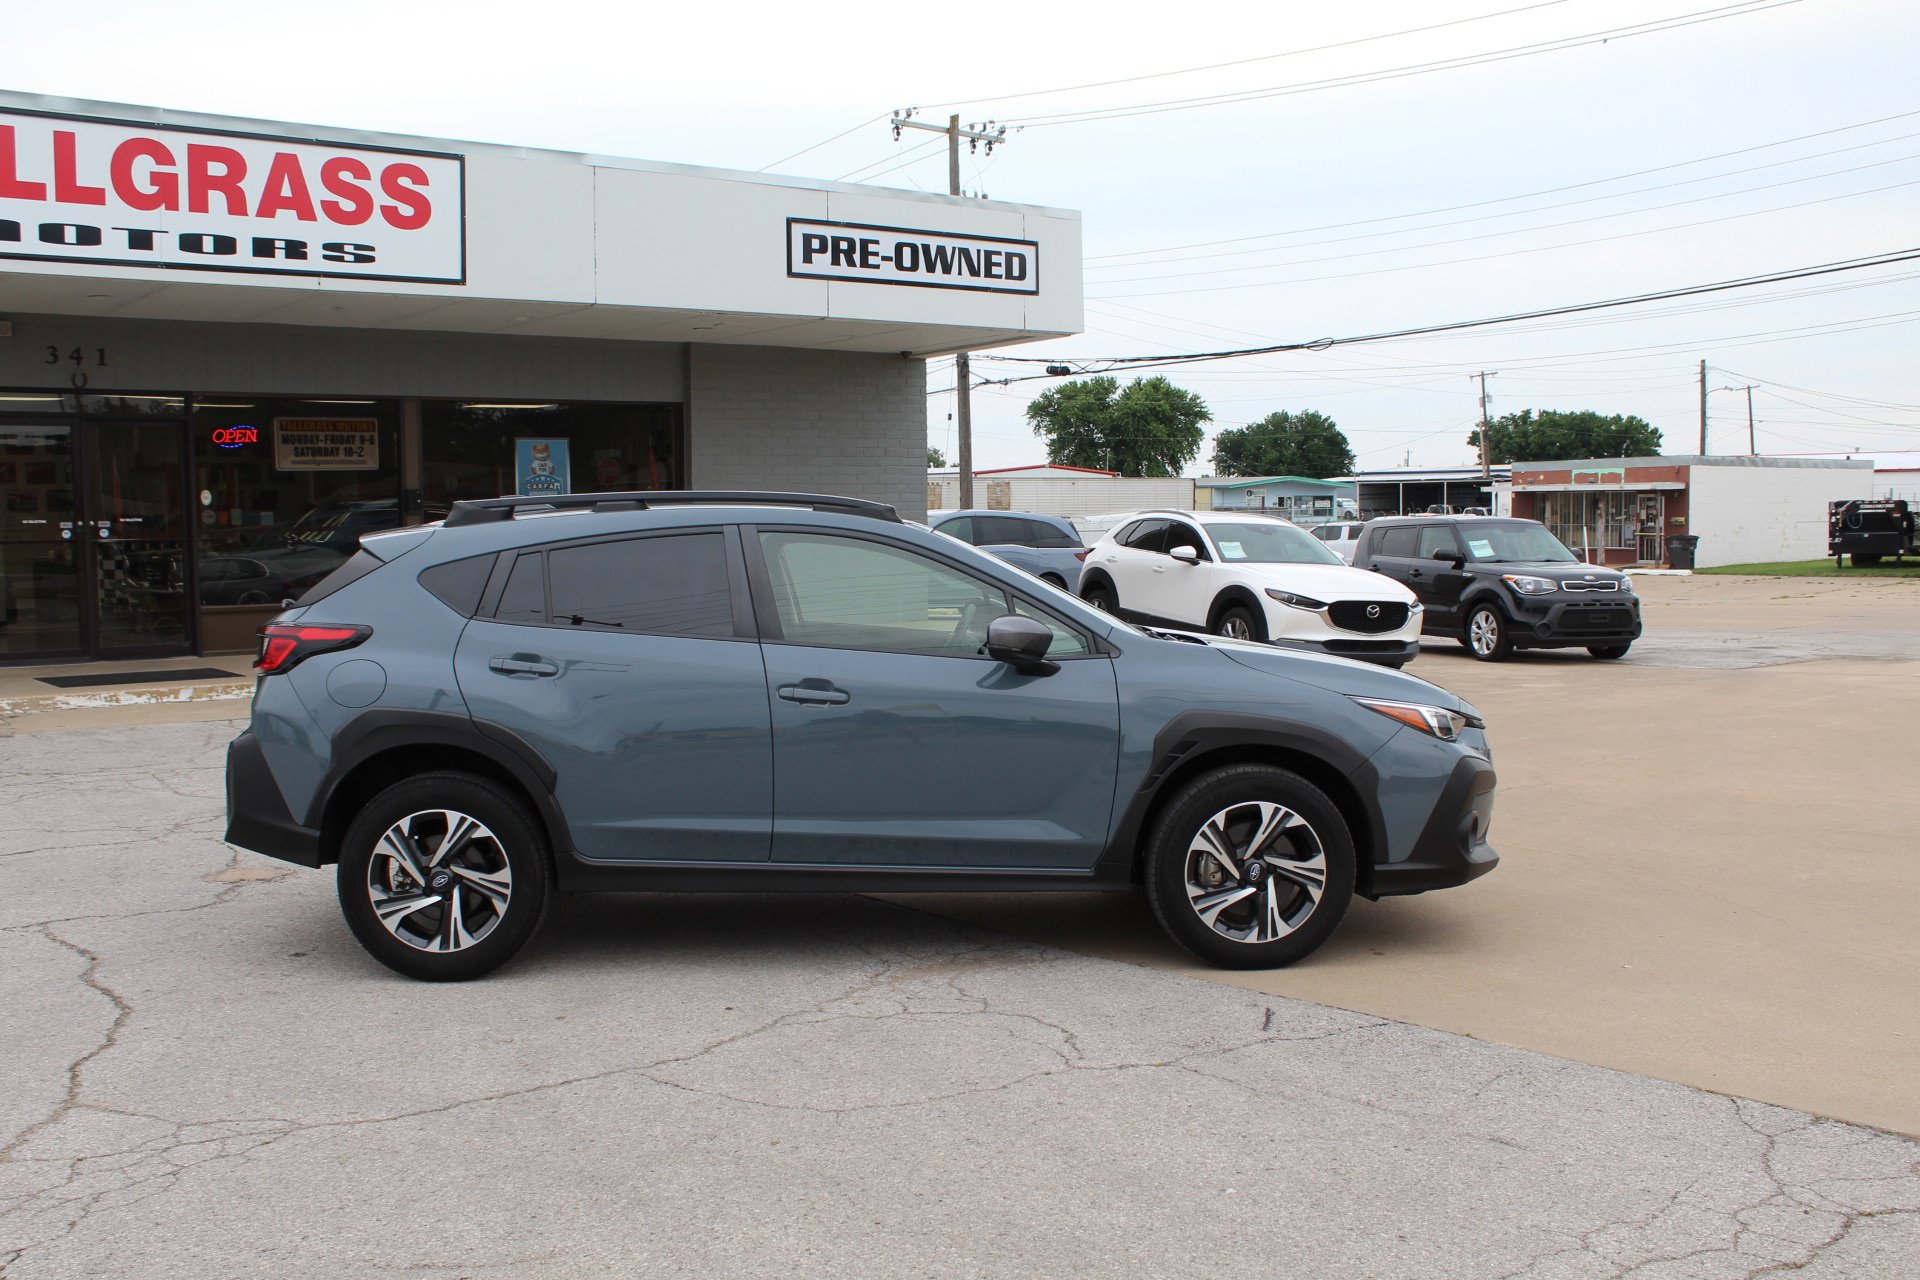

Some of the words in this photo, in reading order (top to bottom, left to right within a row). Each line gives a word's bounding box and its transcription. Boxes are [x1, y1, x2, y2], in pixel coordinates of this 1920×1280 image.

[802, 232, 1027, 281] PRE-OWNED
[280, 421, 335, 431] TALLGRASS
[336, 421, 375, 431] MOTORS
[212, 429, 258, 443] OPEN
[281, 434, 356, 445] MONDAY-FRIDAY
[294, 446, 340, 457] SATURDAY
[344, 446, 364, 457] 10-2
